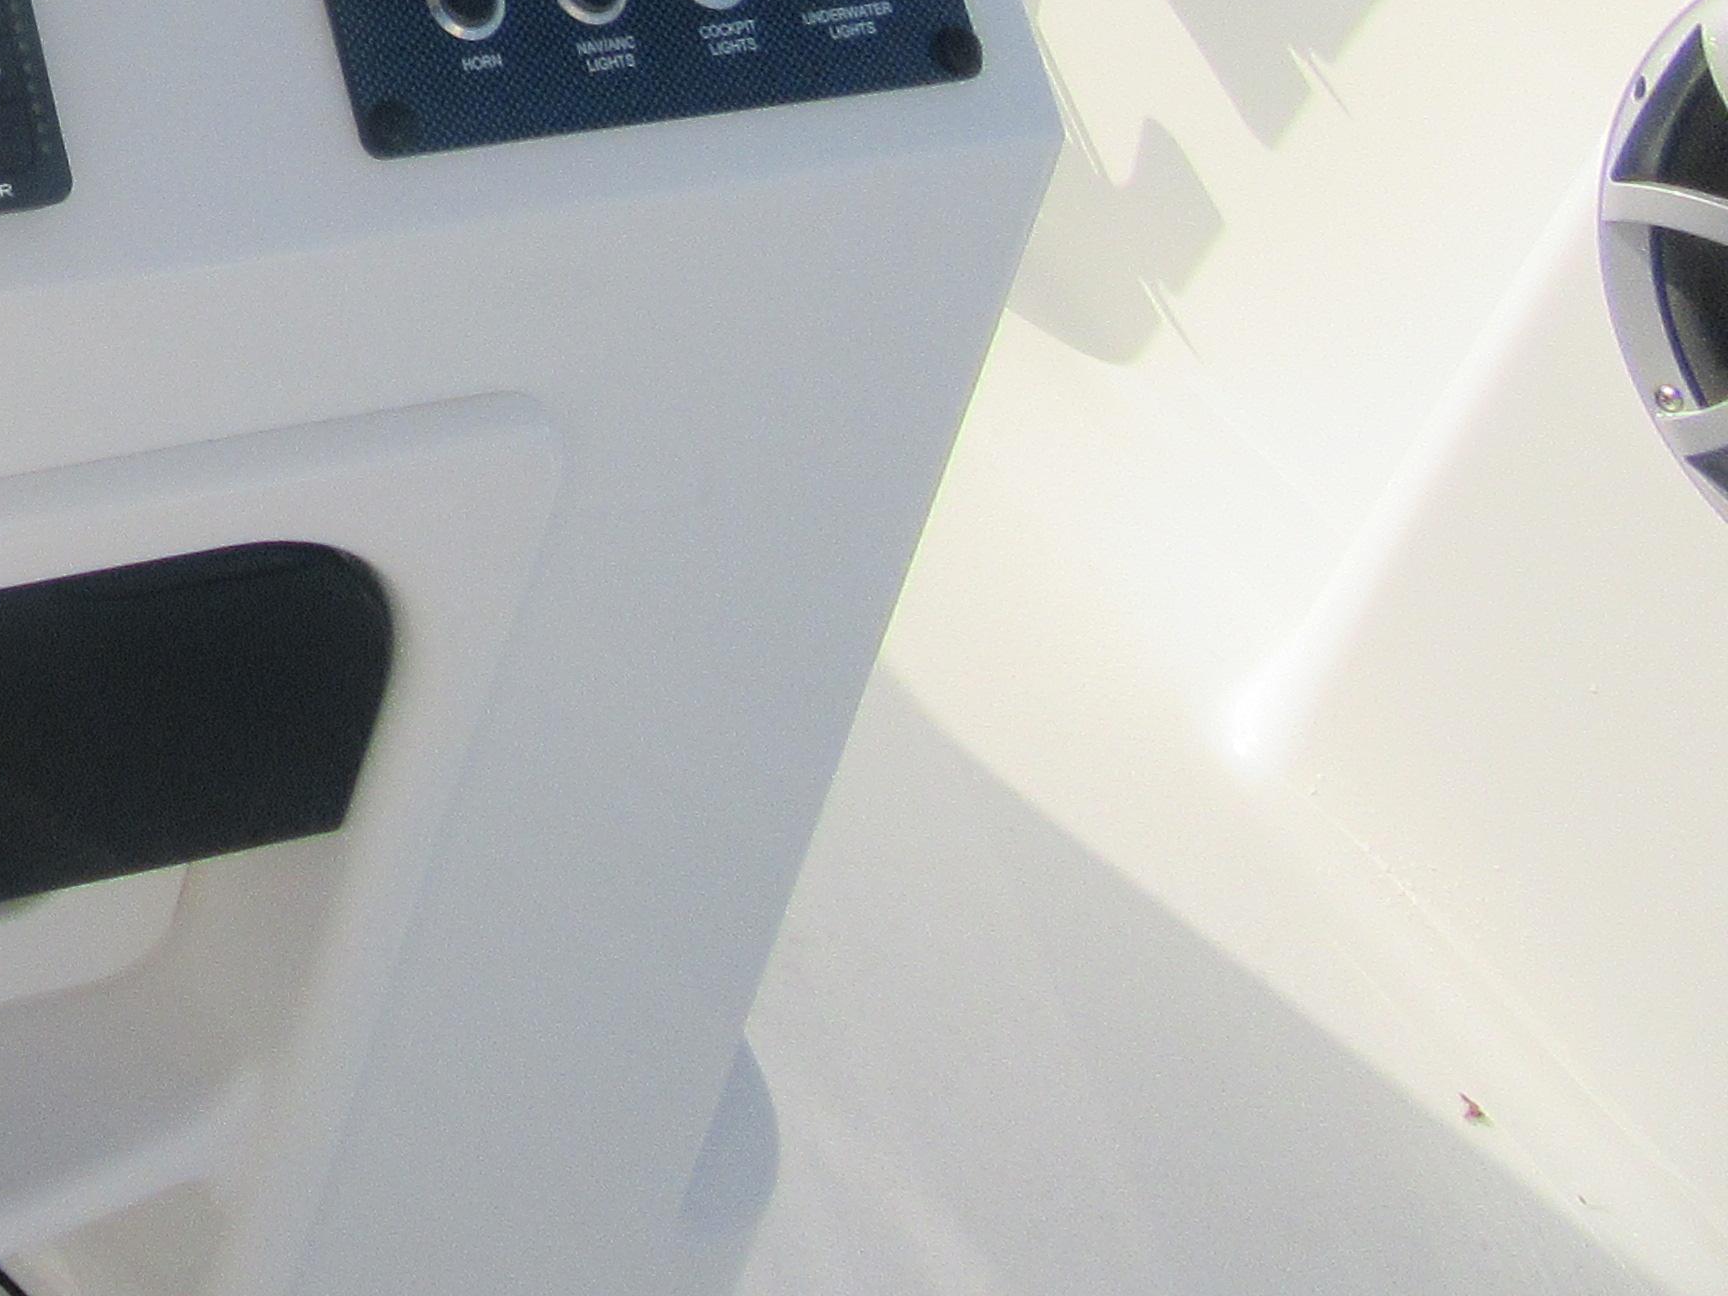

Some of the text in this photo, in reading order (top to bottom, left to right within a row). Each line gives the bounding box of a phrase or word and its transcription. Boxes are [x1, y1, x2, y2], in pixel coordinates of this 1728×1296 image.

[801, 1, 894, 26] UNDERWATER
[698, 18, 757, 41] COCKPIT
[829, 20, 878, 40] LIGHTS
[575, 34, 637, 56] NAV/ANC
[708, 36, 759, 56] LIGHTS
[461, 52, 504, 72] HORN
[585, 52, 636, 73] LIGHTS
